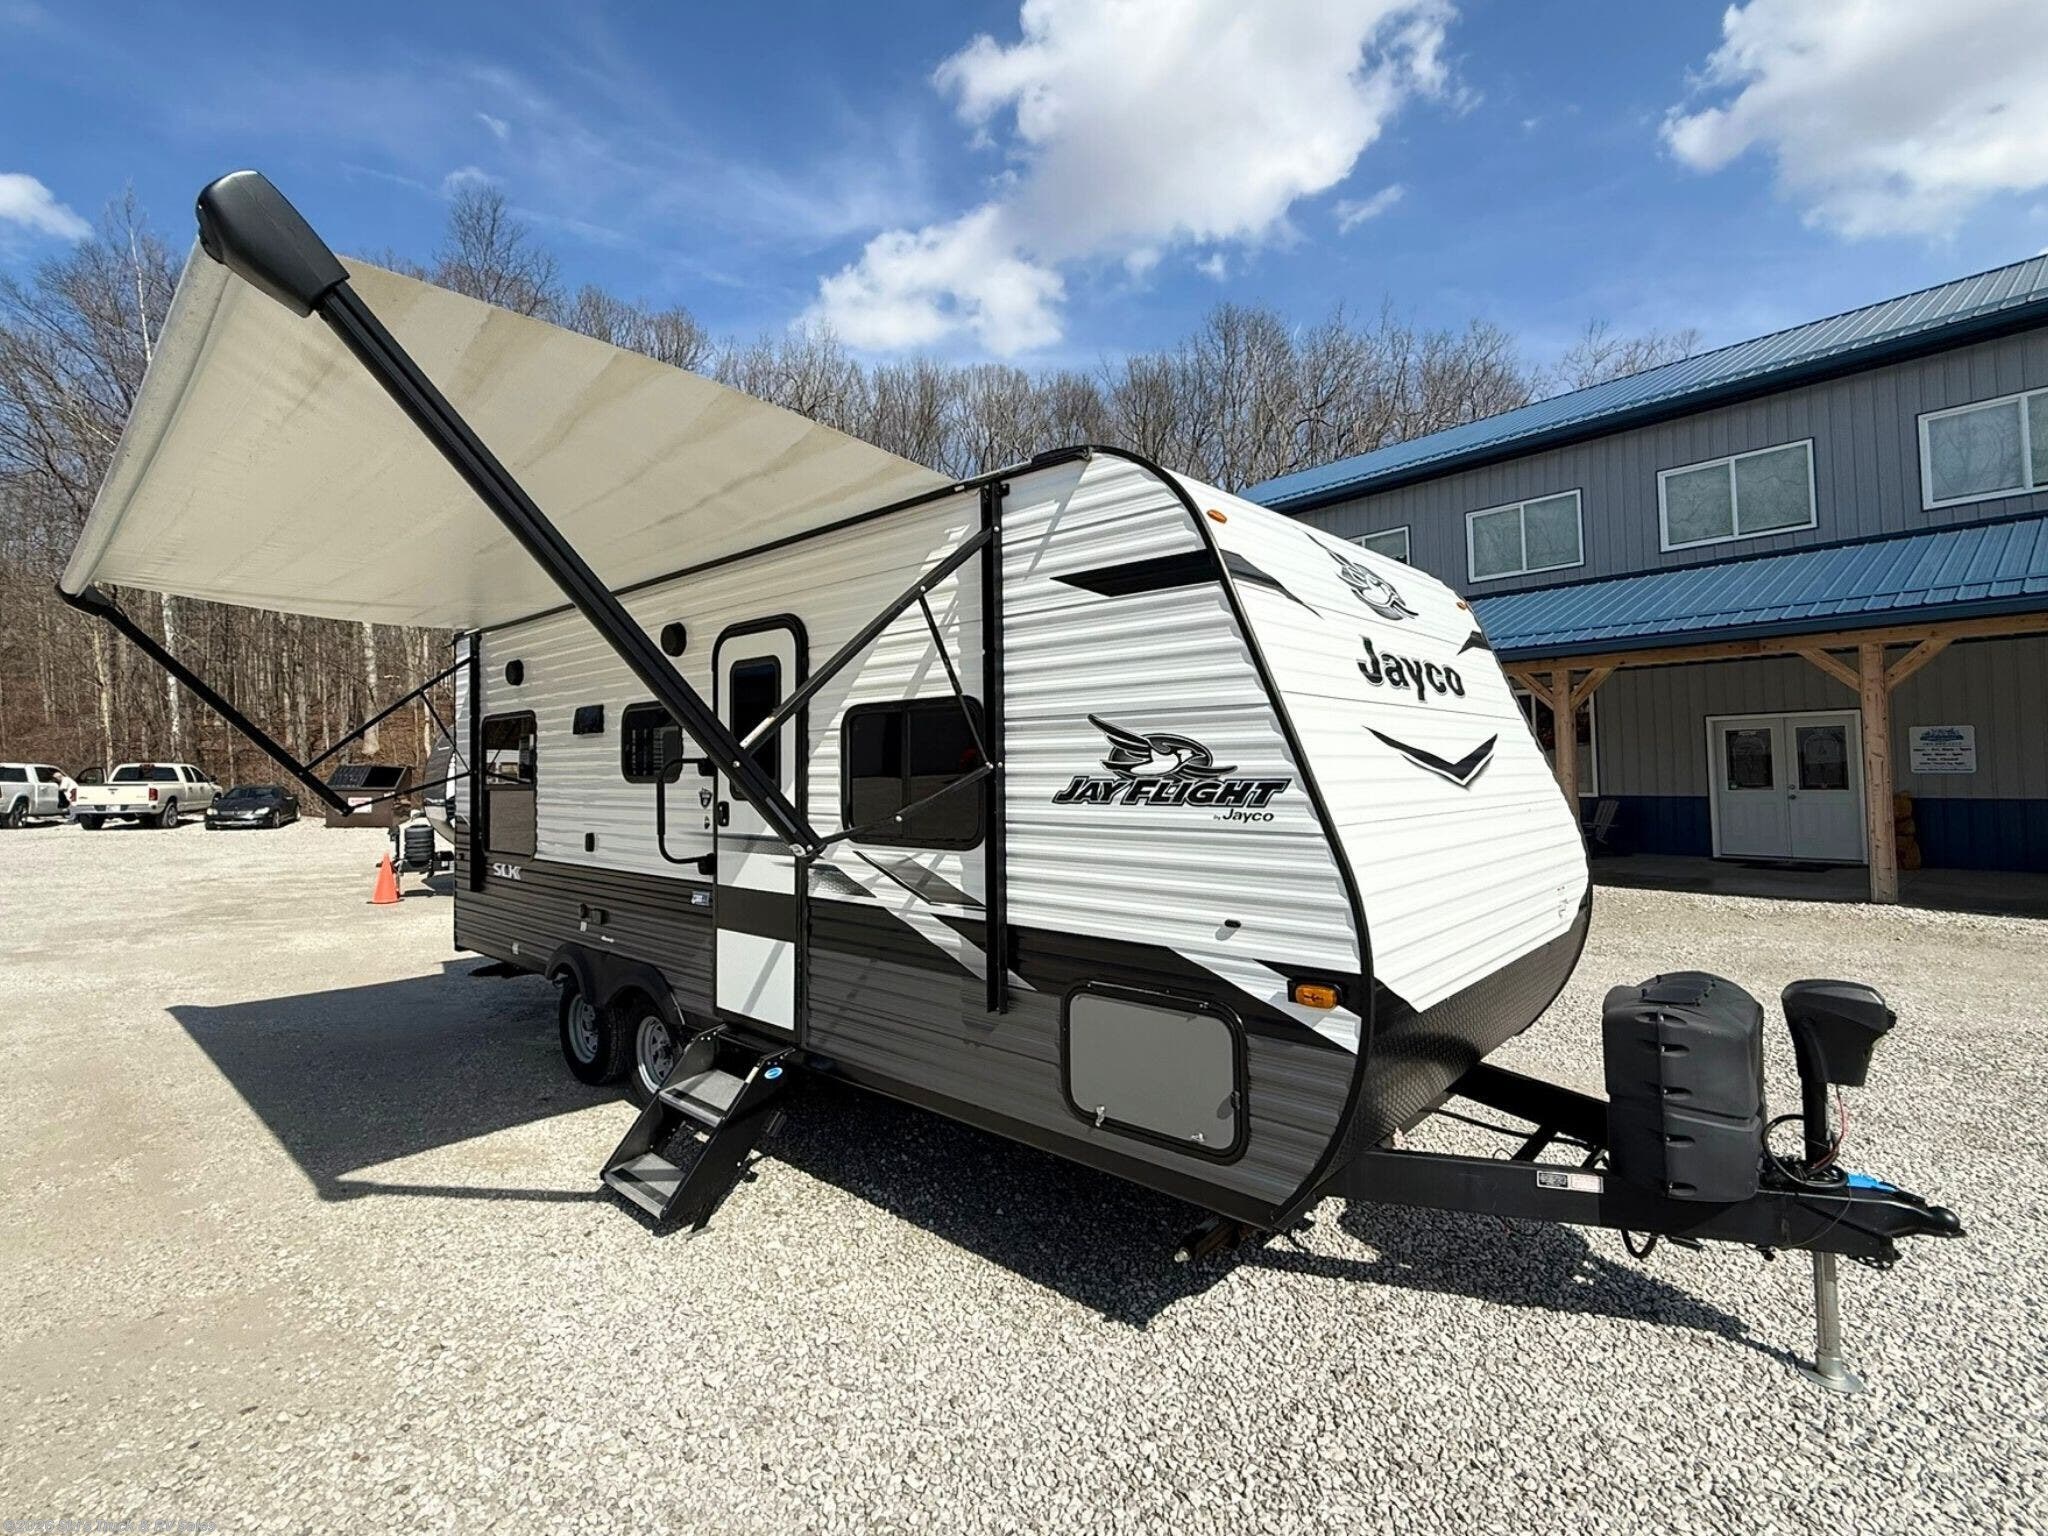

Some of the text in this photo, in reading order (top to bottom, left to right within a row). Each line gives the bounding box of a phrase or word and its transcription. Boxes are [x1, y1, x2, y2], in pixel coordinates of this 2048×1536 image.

[1357, 634, 1465, 703] Jayco
[1052, 776, 1291, 808] JAY FLIGHT
[1223, 808, 1274, 824] Jayco
[493, 863, 521, 880] SLK
